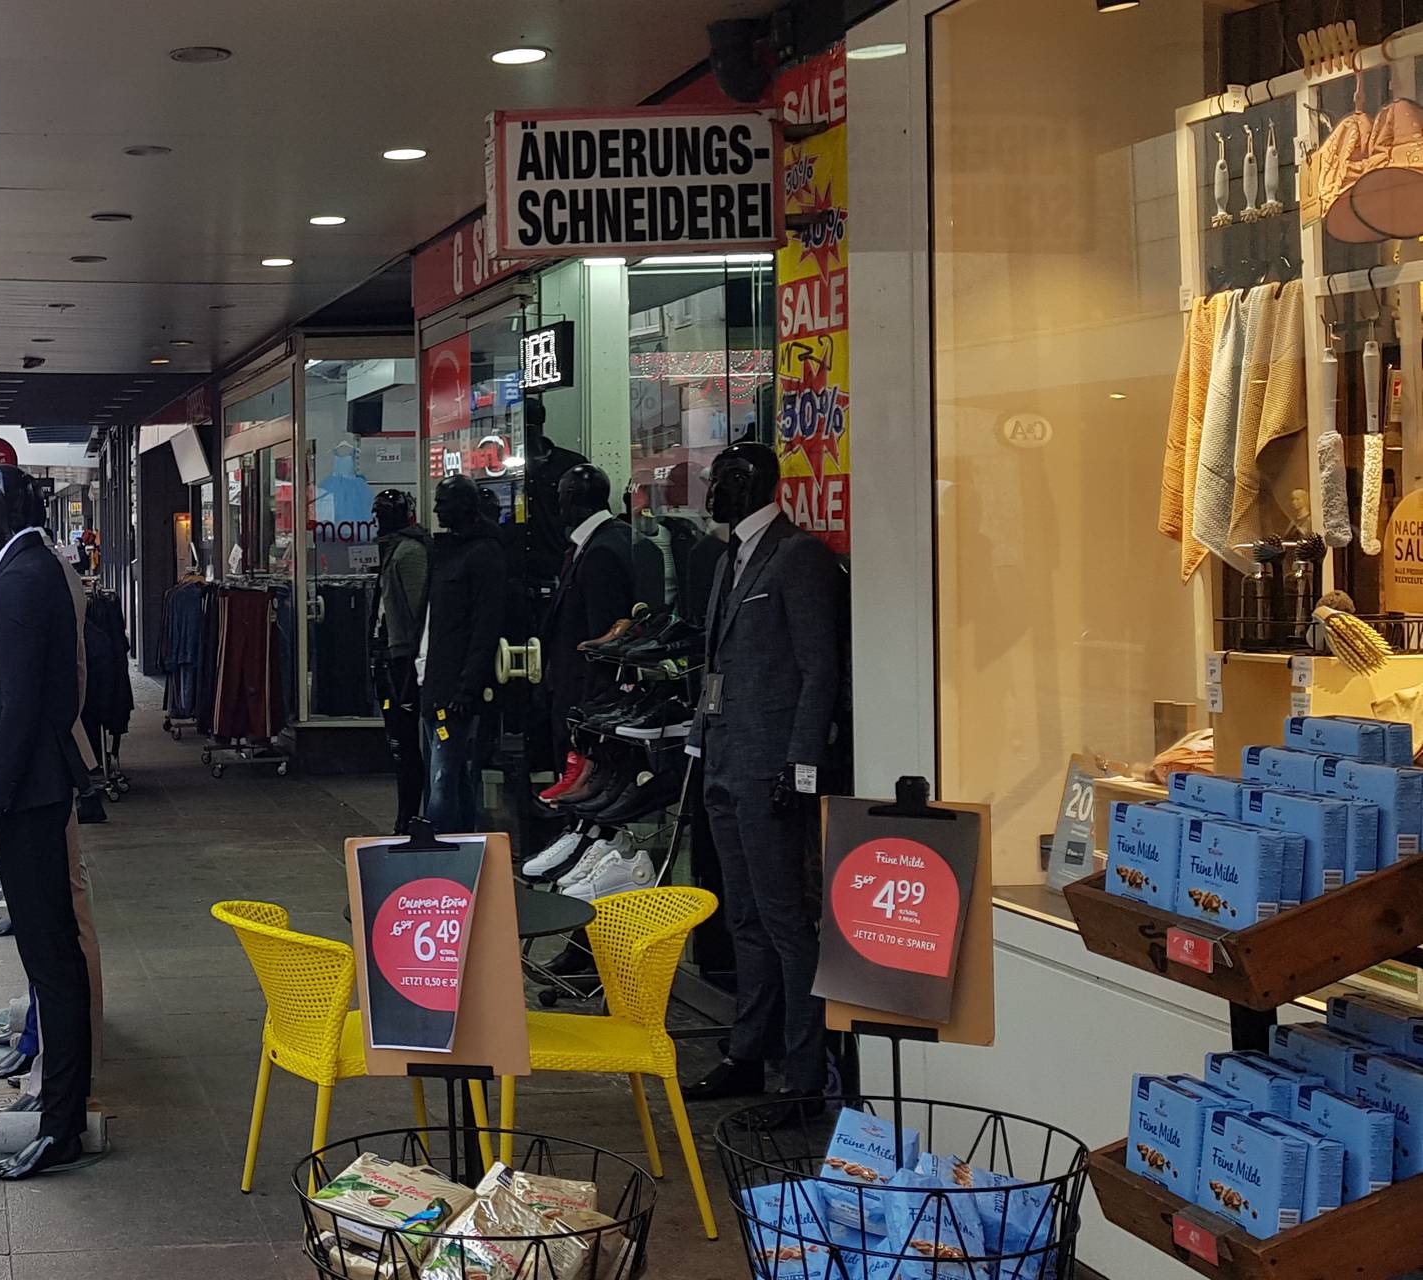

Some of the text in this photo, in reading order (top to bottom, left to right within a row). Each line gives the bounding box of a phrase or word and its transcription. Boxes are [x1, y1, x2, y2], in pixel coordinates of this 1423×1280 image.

[784, 66, 846, 124] SALE
[517, 121, 770, 181] ÄNDERUNGS-
[518, 183, 772, 246] SCHNEIDEREI
[781, 274, 845, 337] SALE
[781, 385, 844, 440] 50%
[781, 479, 845, 532] SALE
[875, 851, 925, 869] Feine Milde
[1117, 834, 1160, 863] Feine Milde
[1190, 855, 1239, 885] Feine Milde
[853, 929, 876, 940] JETZT
[897, 935, 905, 946] €
[906, 937, 936, 952] SPAREN
[400, 976, 423, 986] JETZT
[836, 1133, 865, 1150] Feine
[1138, 1111, 1181, 1148] Feine Milde
[1212, 1146, 1262, 1187] Feine Milde
